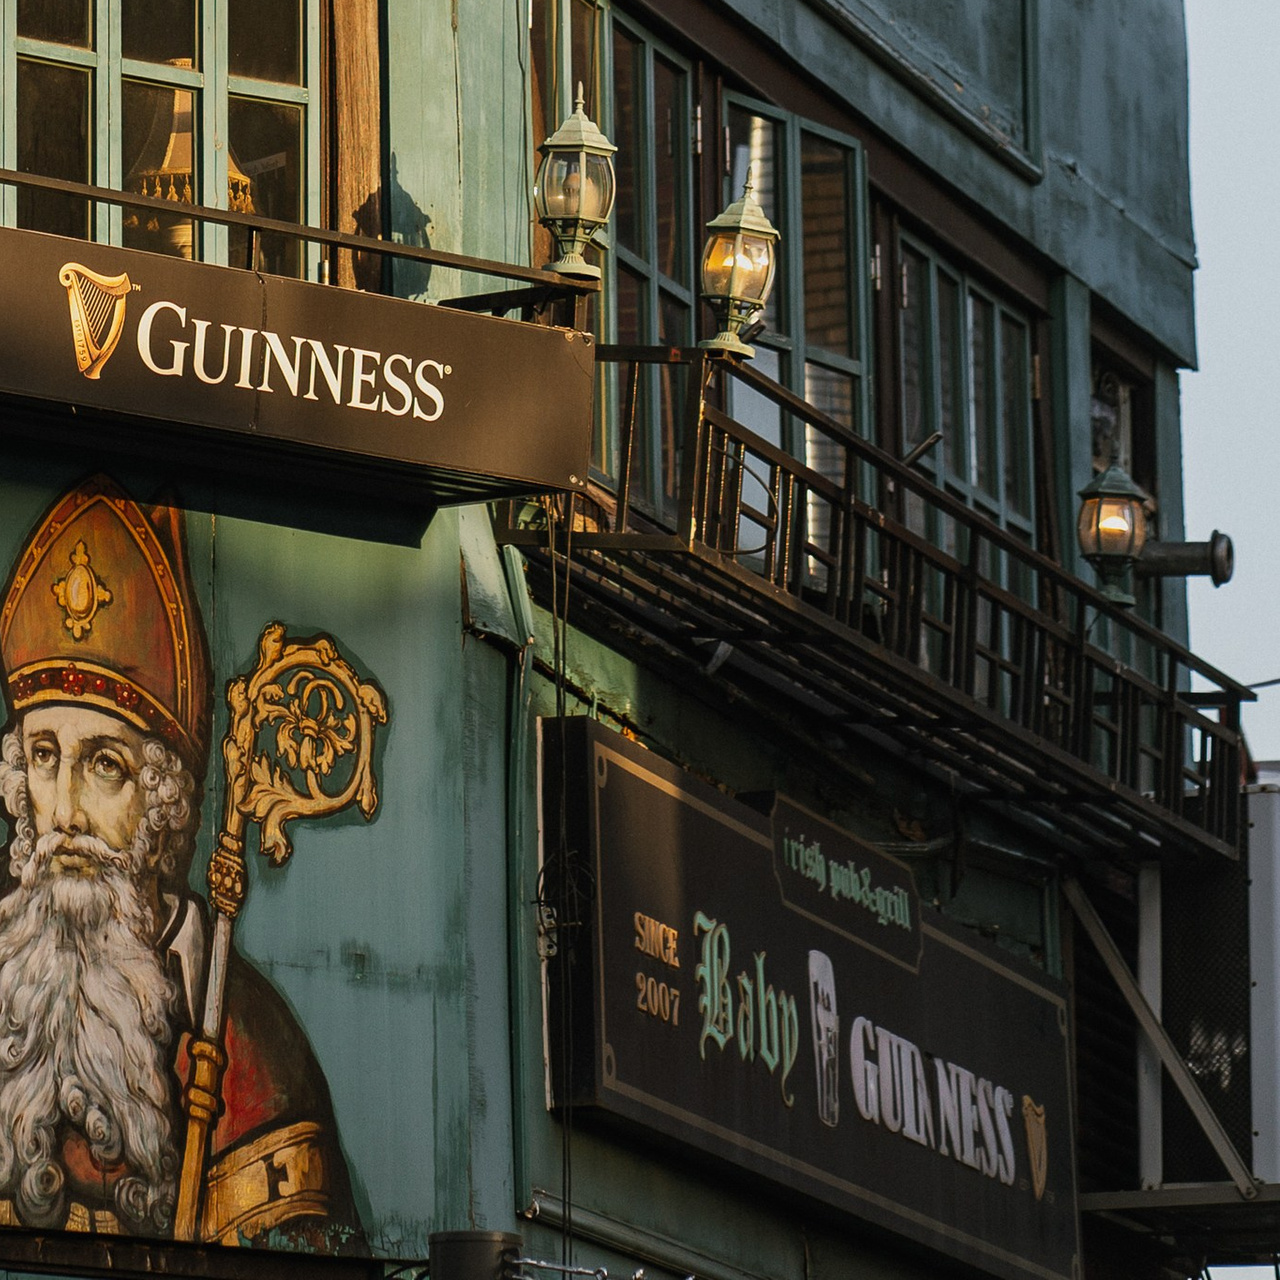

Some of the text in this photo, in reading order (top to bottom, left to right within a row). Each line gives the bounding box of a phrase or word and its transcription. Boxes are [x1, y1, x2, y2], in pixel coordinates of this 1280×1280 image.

[136, 300, 446, 422] GUINNESS
[634, 911, 680, 969] SINCE
[636, 971, 681, 1027] 2007
[693, 910, 800, 1109] Baby
